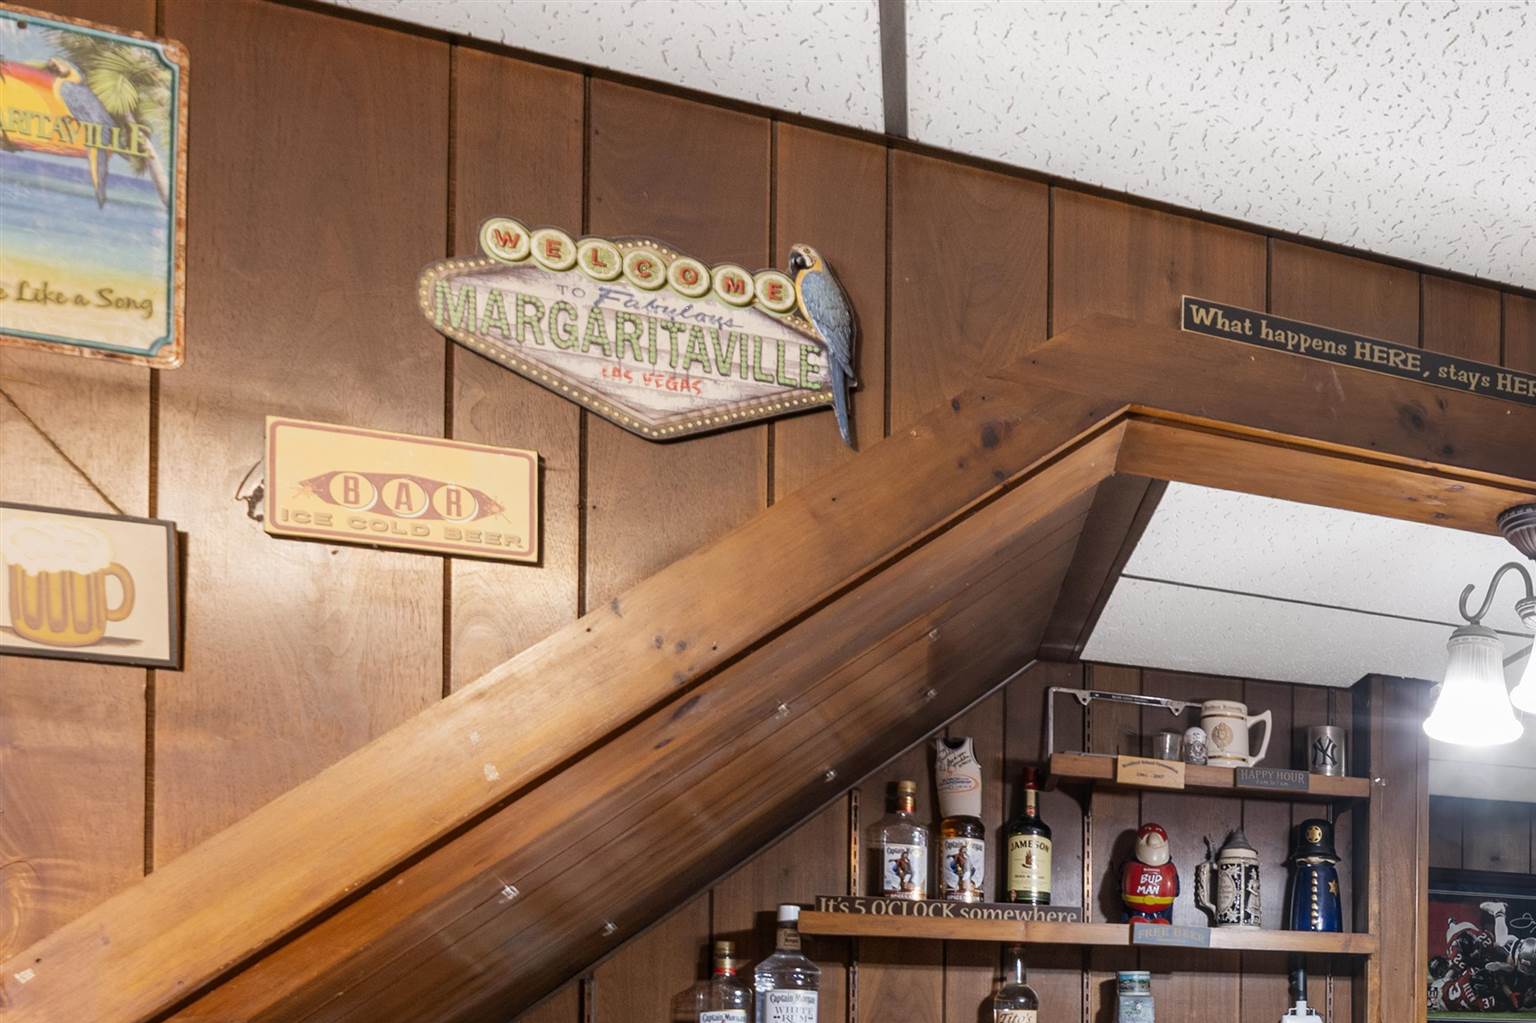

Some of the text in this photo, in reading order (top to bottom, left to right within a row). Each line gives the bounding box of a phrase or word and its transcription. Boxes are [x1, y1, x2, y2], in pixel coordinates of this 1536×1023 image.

[494, 226, 784, 302] WELCOME
[16, 280, 67, 305] Like
[74, 293, 90, 307] a
[96, 287, 154, 319] Song
[556, 283, 744, 330] TO Fabulous
[433, 278, 826, 390] MARGARITAVILLE
[1189, 304, 1253, 336] What
[1260, 319, 1348, 358] happens
[1437, 361, 1492, 391] stays
[600, 366, 703, 396] LAS VEGAS
[342, 474, 463, 518] BAR
[280, 508, 525, 549] ICE COLD BEER
[1311, 735, 1339, 769] NY
[1240, 768, 1273, 782] HAPPY
[1276, 771, 1305, 784] HOUR
[1008, 839, 1051, 853] JAMESON
[1136, 885, 1161, 896] MAN
[1140, 873, 1163, 886] BUD
[819, 897, 1078, 923] It's 5 O'CLOCK somewhere
[770, 993, 794, 1004] Captain
[781, 1014, 810, 1023] RUM
